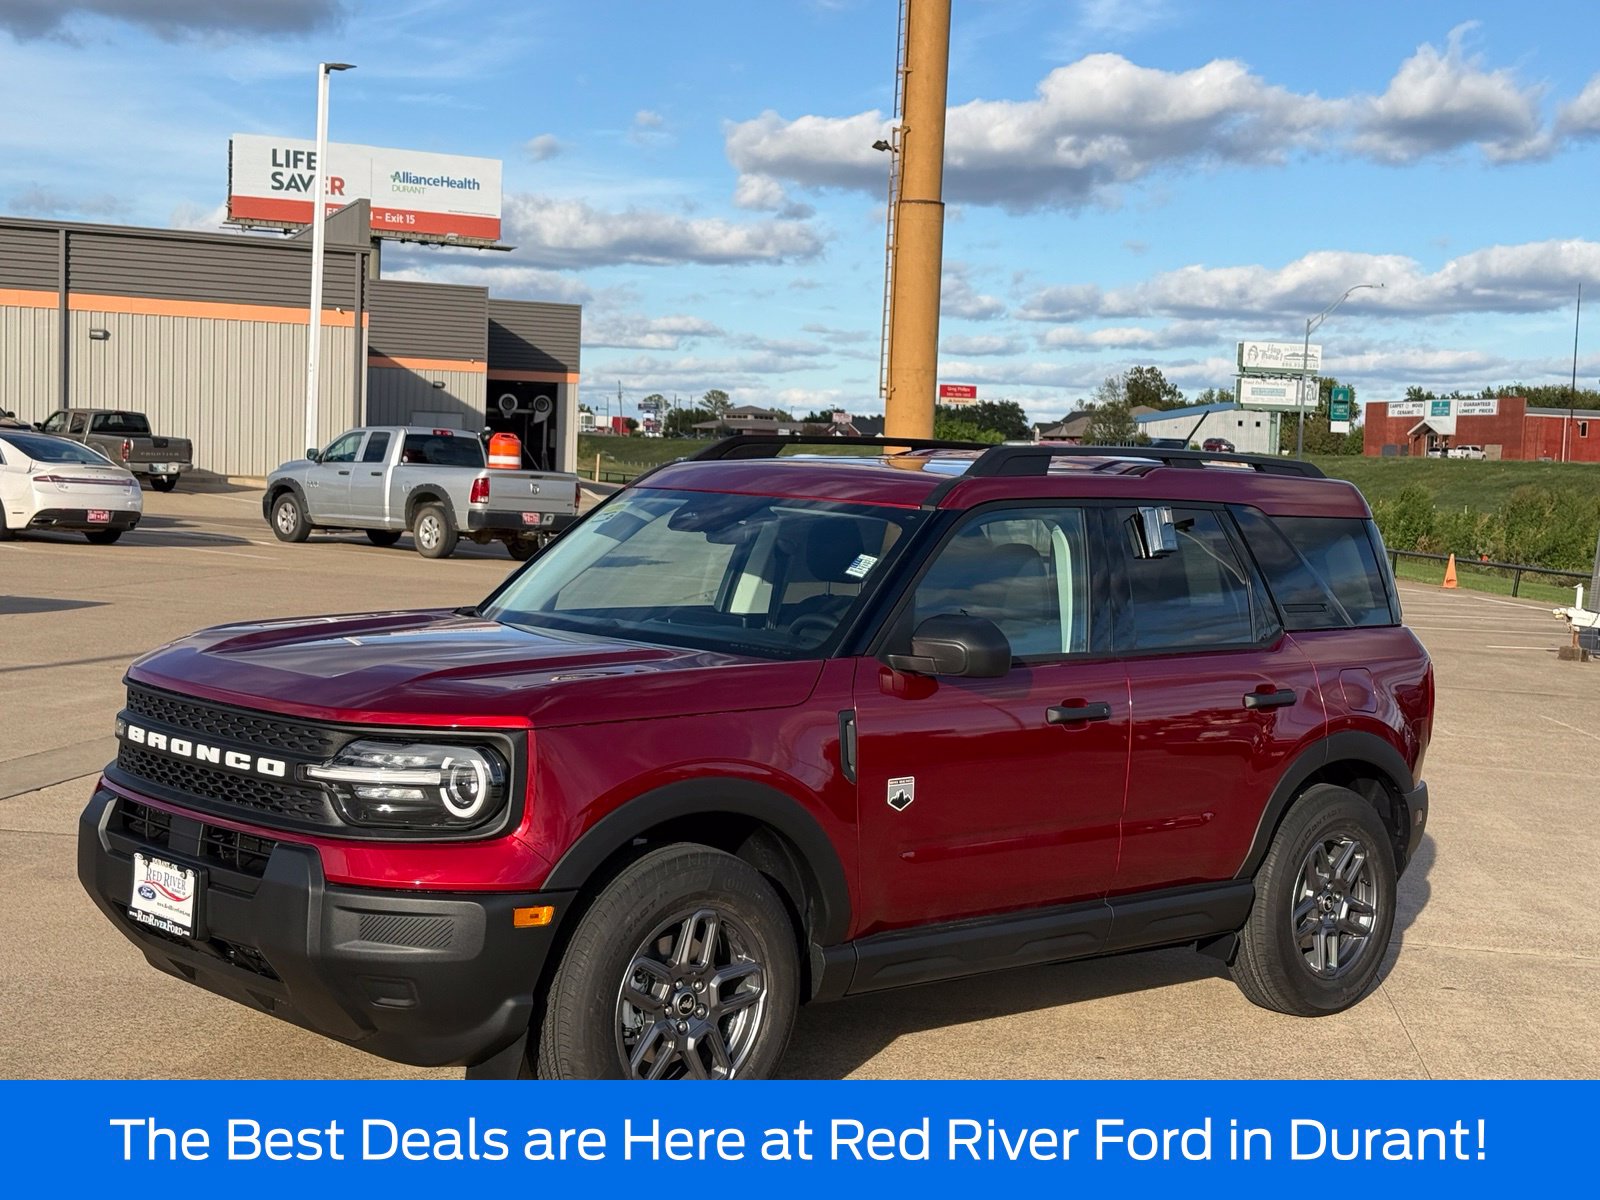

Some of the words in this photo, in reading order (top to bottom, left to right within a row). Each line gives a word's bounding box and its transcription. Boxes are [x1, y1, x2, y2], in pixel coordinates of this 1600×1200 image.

[272, 148, 317, 170] LIFE
[271, 171, 345, 196] SAVR
[391, 171, 480, 190] AllianceHealth
[392, 184, 427, 195] DURANT
[385, 212, 404, 224] Exit
[406, 213, 416, 225] 15
[127, 724, 286, 777] BRONCO
[146, 867, 162, 882] RED
[163, 871, 186, 891] RIVER
[140, 885, 154, 899] Ford
